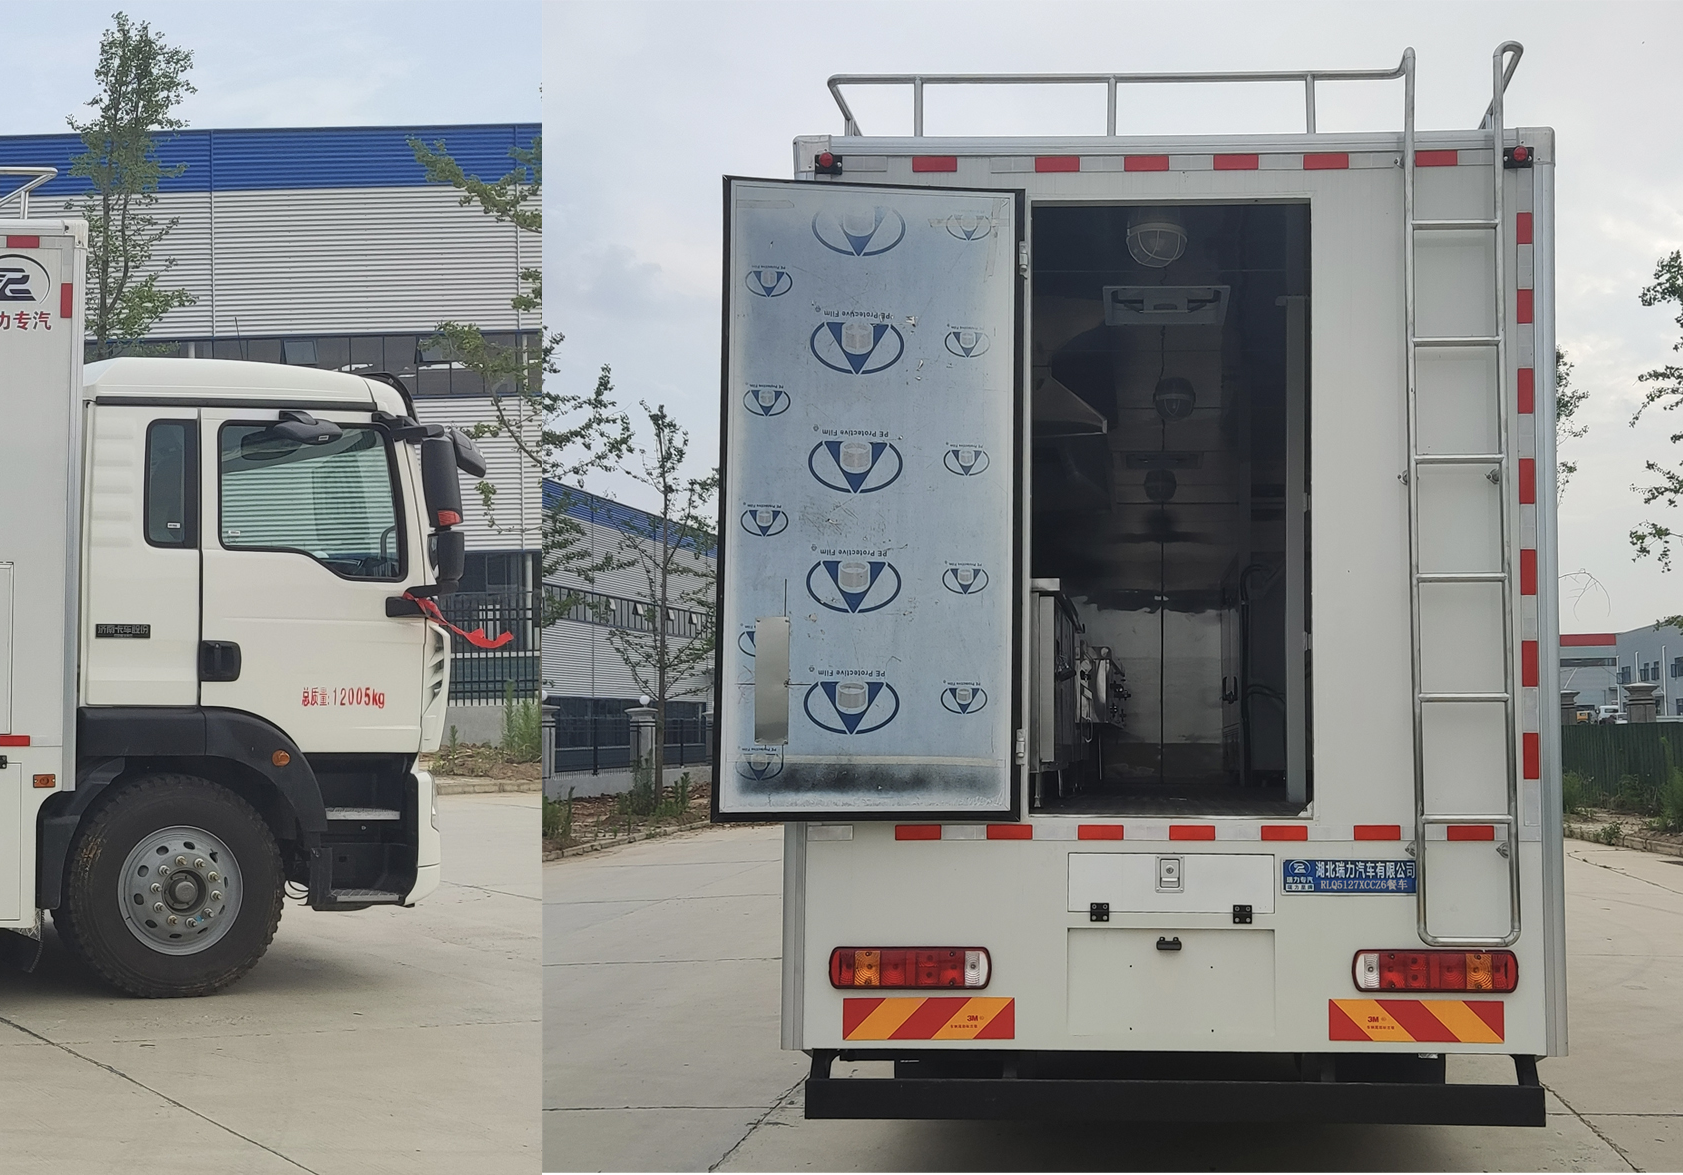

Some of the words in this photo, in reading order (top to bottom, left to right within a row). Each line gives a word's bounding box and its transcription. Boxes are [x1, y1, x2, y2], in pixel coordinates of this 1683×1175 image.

[838, 549, 875, 557] Protective
[1315, 861, 1415, 879] 湖北瑞力汽车有限公司
